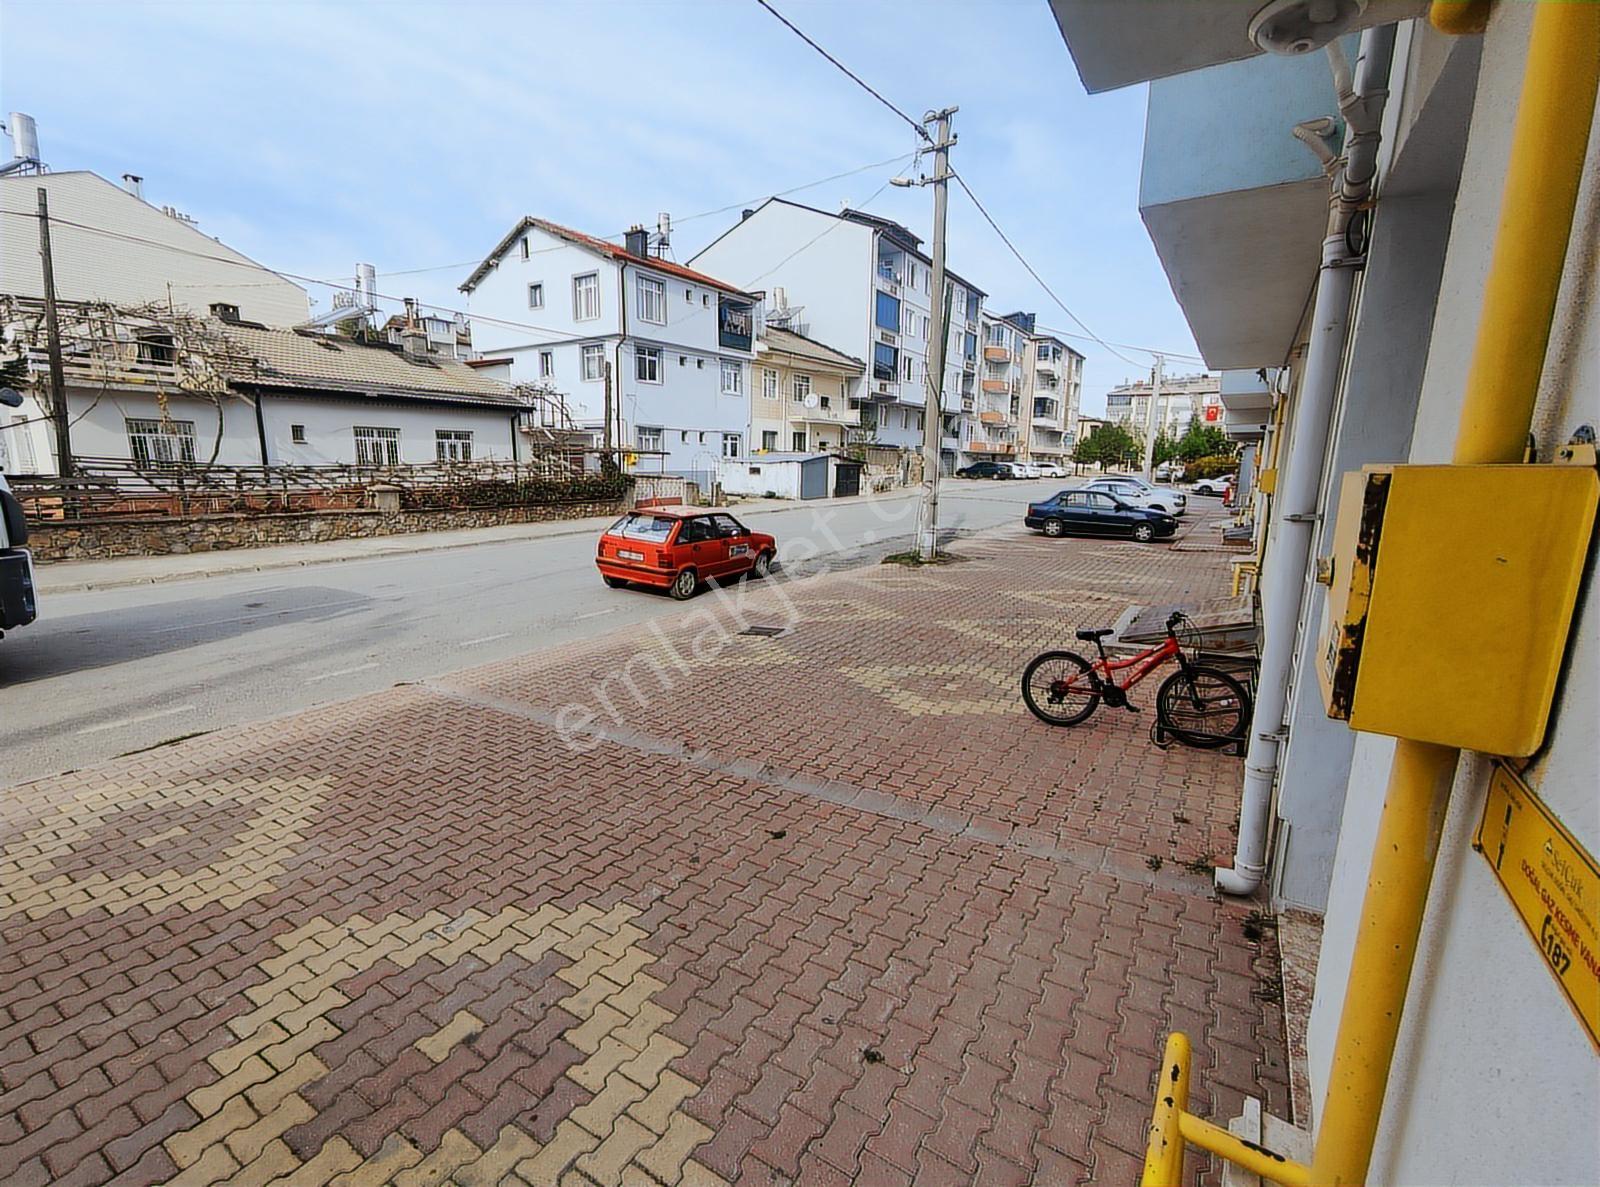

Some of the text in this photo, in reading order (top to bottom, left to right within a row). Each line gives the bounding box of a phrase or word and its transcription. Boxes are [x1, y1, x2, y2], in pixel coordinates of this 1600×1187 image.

[1521, 858, 1541, 894] DOĞAL
[1540, 888, 1555, 914] GAZ
[1554, 905, 1580, 949] KESME
[1547, 934, 1571, 976] 187
